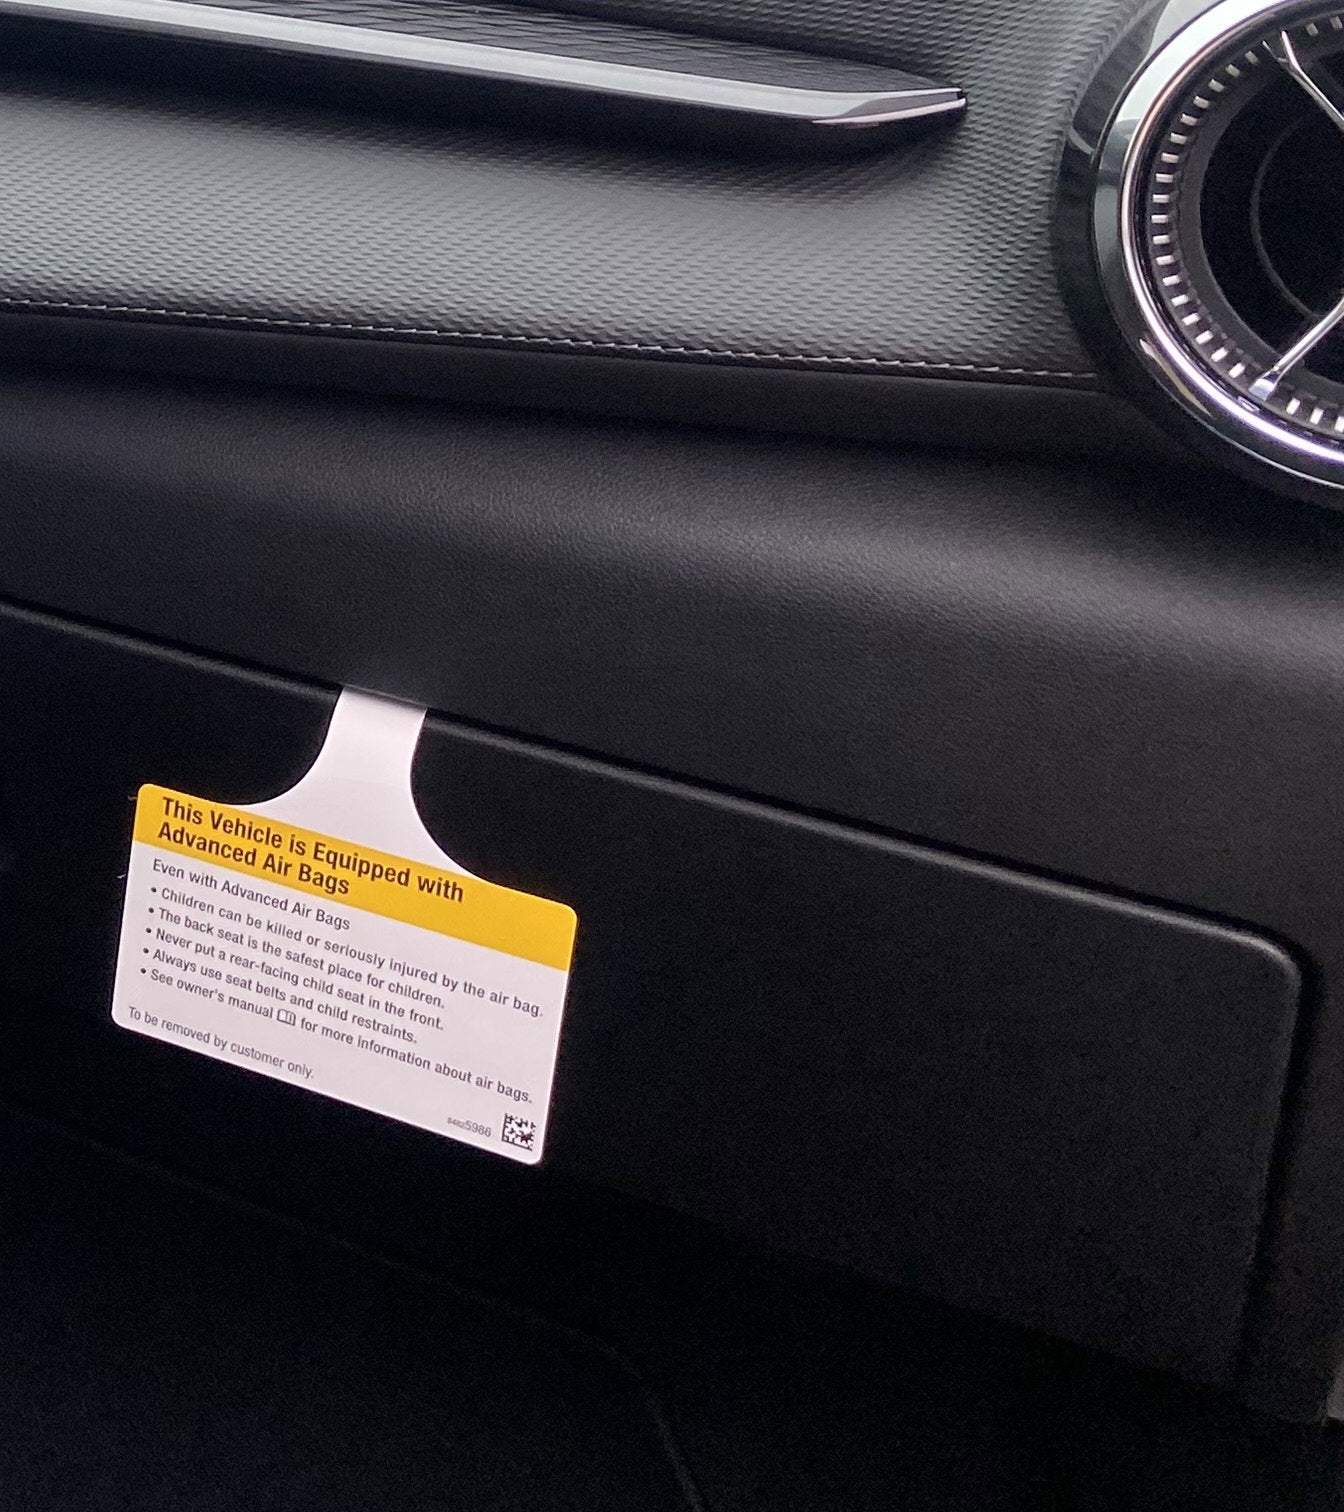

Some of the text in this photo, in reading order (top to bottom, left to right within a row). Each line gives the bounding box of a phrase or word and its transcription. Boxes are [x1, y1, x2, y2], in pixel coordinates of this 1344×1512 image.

[152, 857, 350, 929] Even with Advanced Air Bags
[157, 821, 349, 894] Advanced Air Bags
[162, 796, 463, 902] This Vehicle is Equipped with
[152, 948, 416, 1043] Always use seat belts and child restraints.
[155, 927, 443, 1030] Never put a rear-facing child seat in the front.
[158, 906, 444, 1008] The back seat is the safest place for children.
[161, 887, 542, 1017] Children can be killed or seriously injured by the air bag.
[128, 1005, 313, 1079] To be removed by customer only.
[150, 968, 531, 1103] See owner's manual for more information about air bags.
